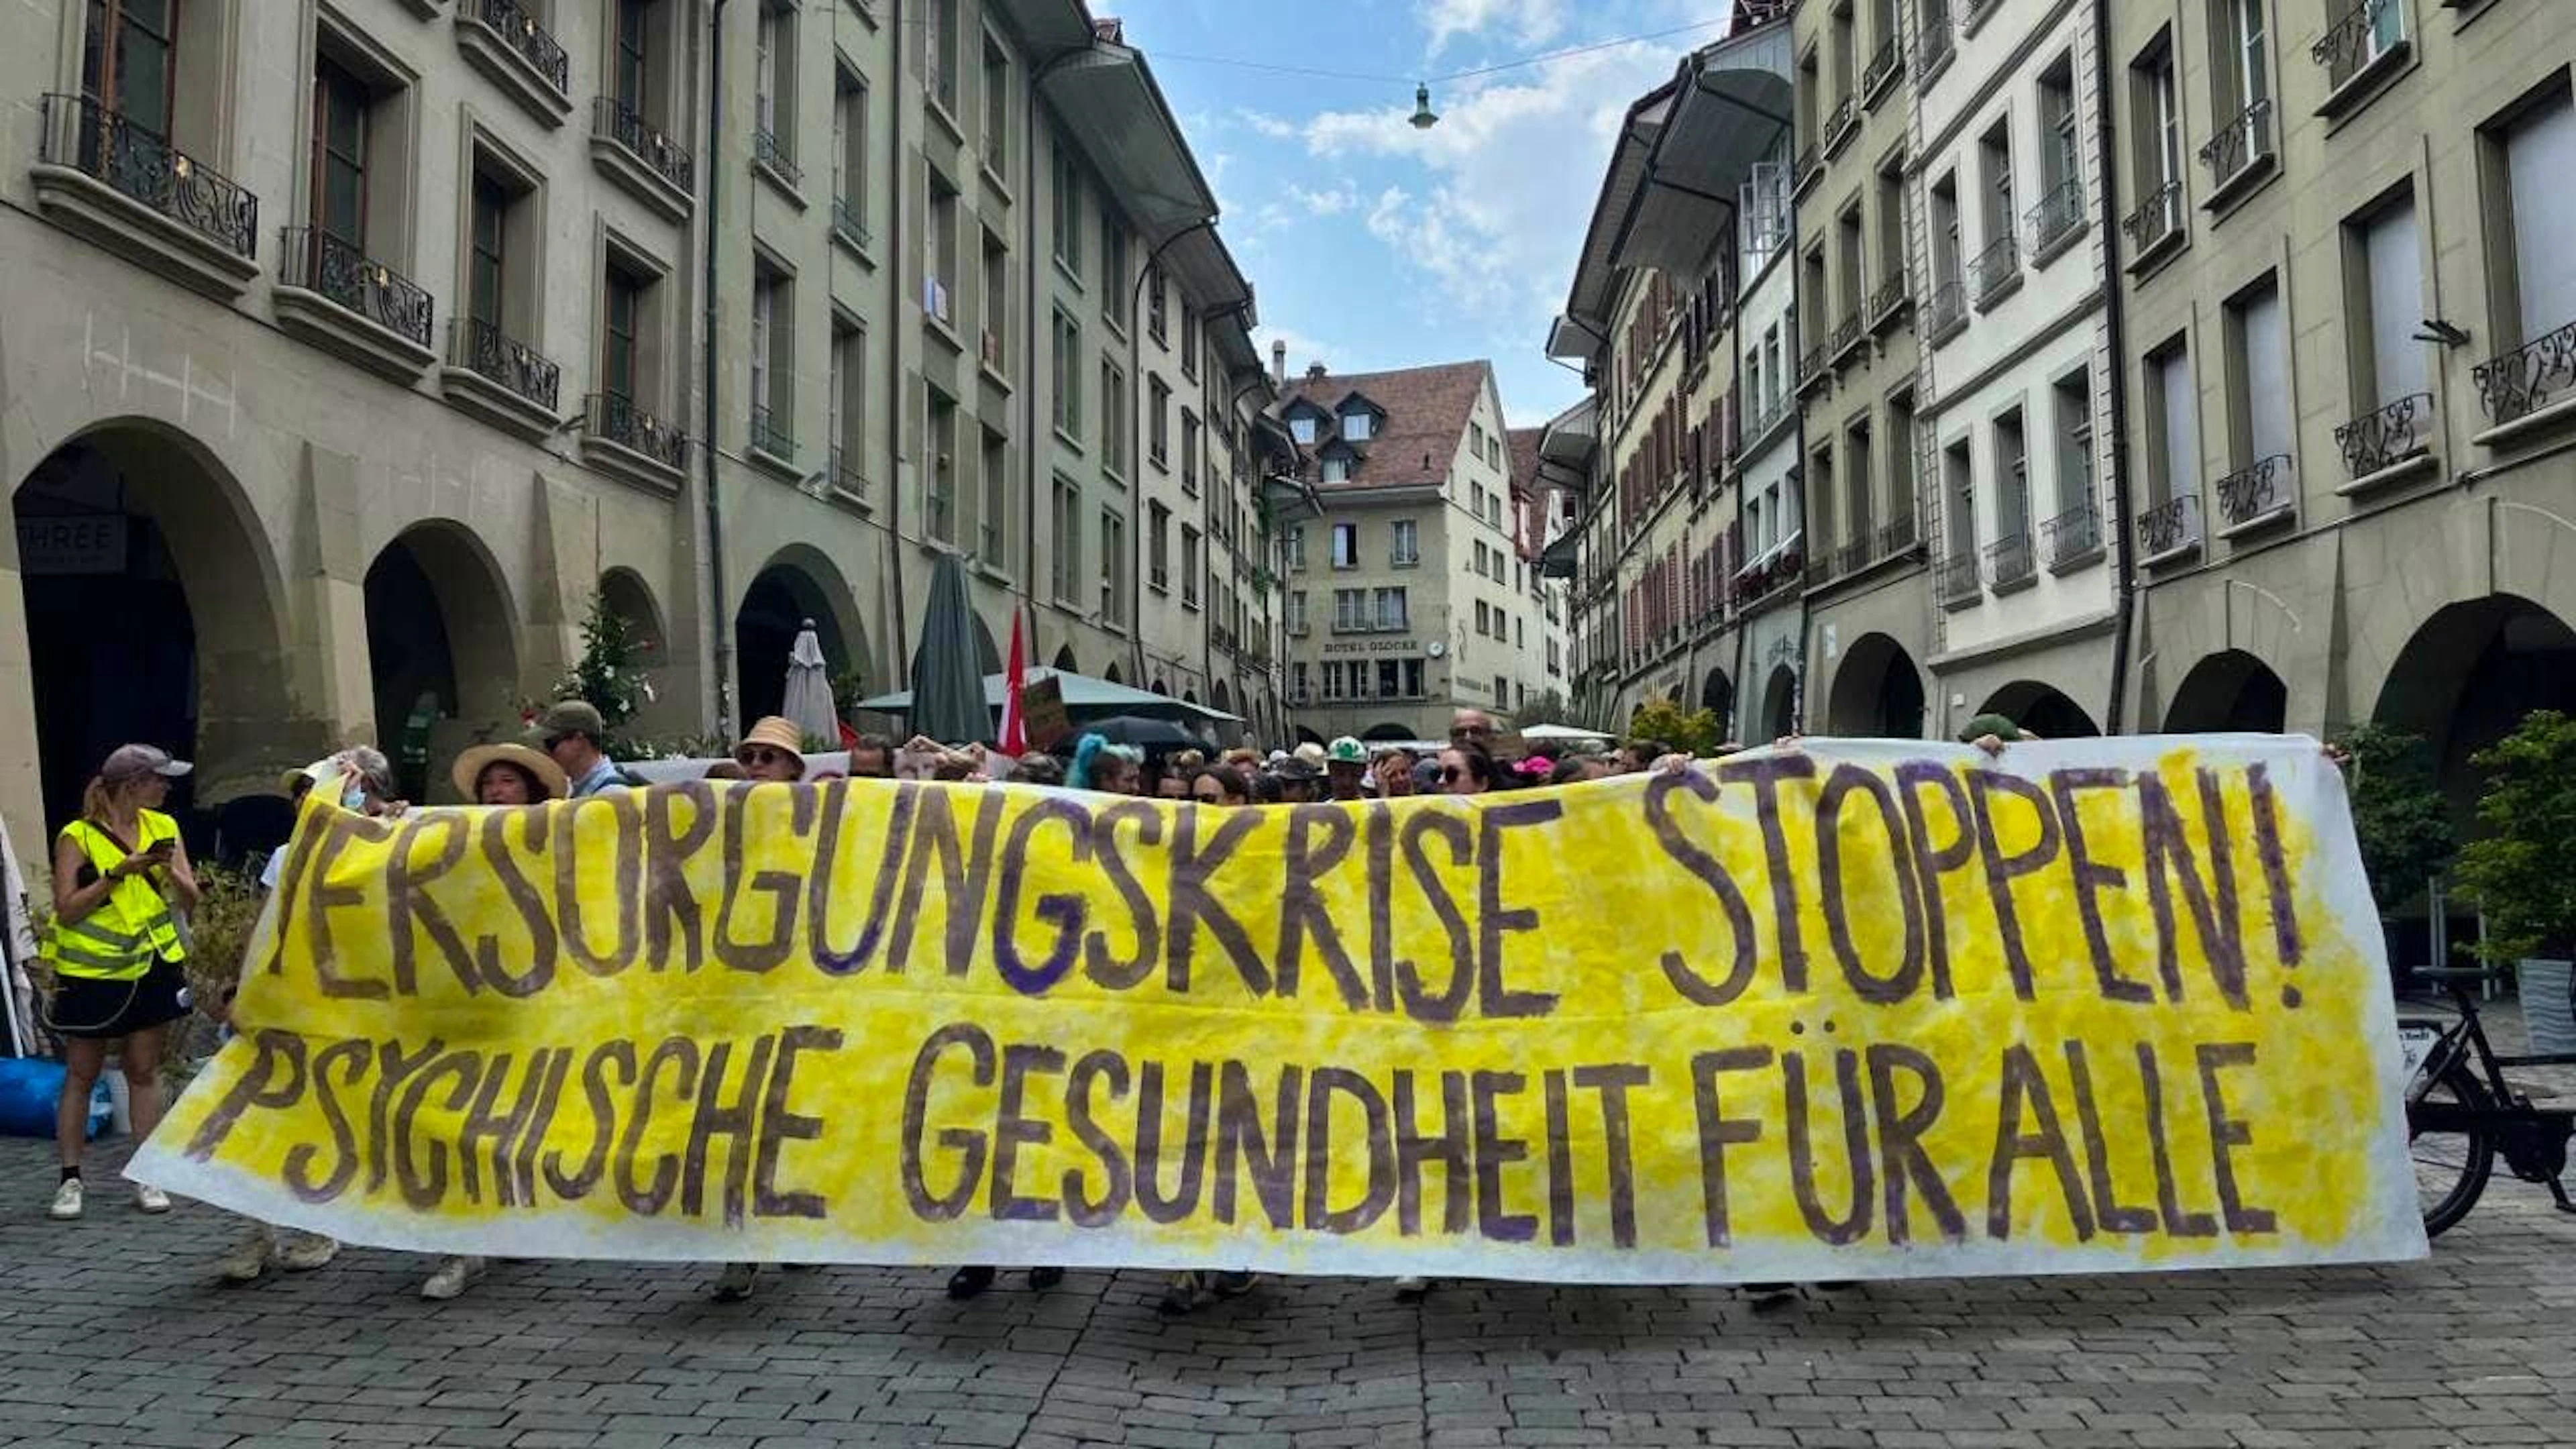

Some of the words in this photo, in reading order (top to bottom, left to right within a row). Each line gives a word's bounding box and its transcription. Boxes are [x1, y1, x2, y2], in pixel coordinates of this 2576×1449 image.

[1324, 642, 1365, 653] HOTEL
[1645, 755, 2306, 1014] STOPPEN!
[182, 1025, 843, 1231] PSYCHISCHE
[902, 1023, 1649, 1249] GESUNDHEIT
[1692, 1019, 1967, 1249] FÜR
[1988, 1040, 2277, 1244] ALLE
